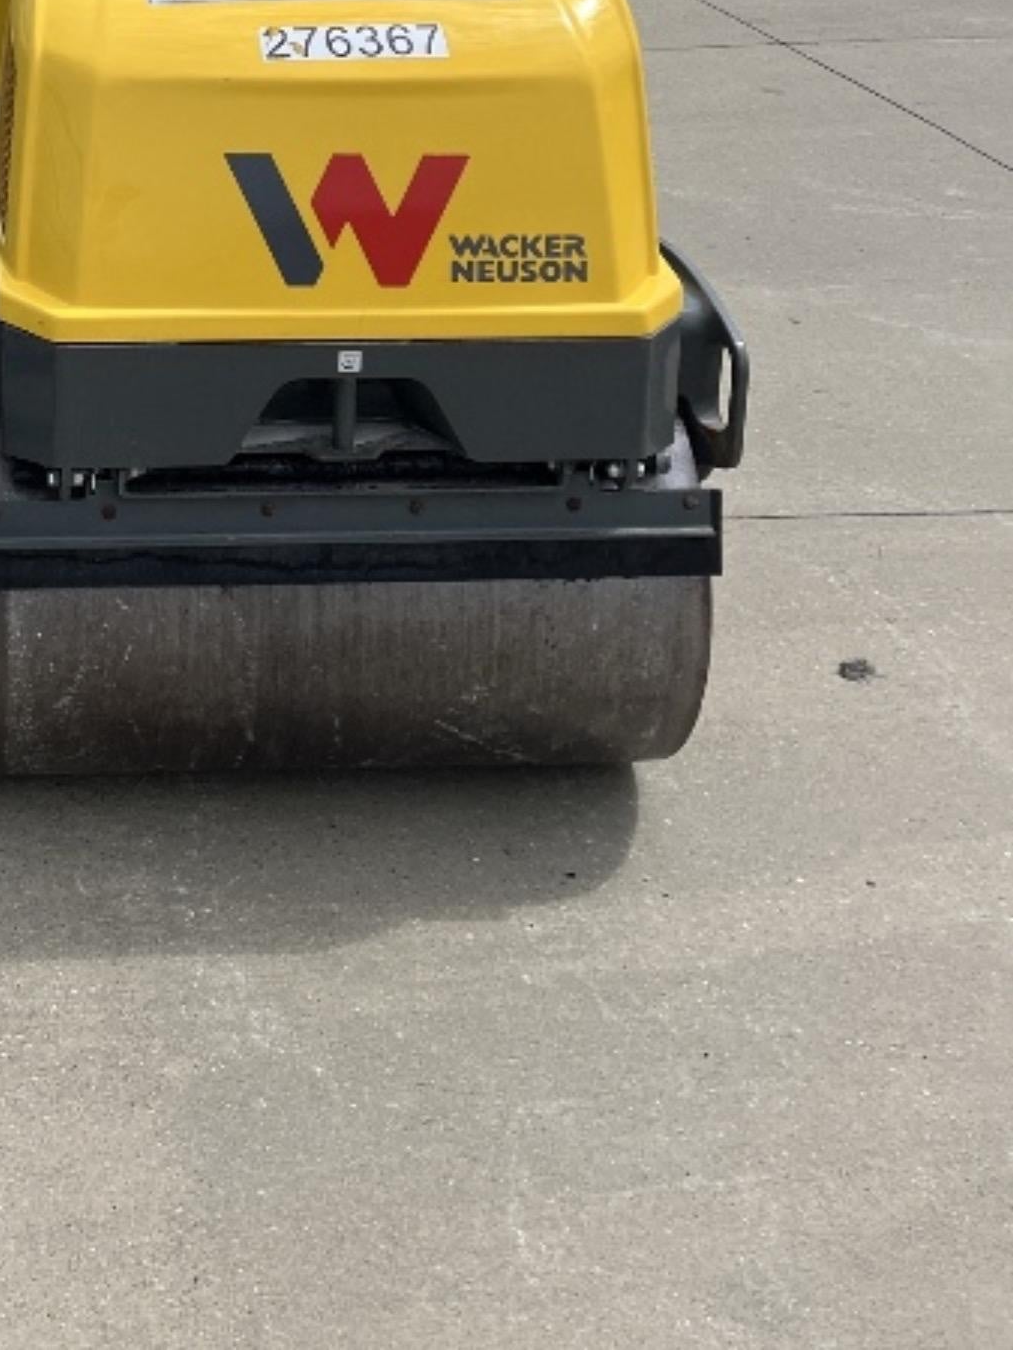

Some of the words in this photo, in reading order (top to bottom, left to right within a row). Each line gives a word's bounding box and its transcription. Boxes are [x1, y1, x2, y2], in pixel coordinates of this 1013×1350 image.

[263, 23, 439, 59] 276367
[448, 233, 587, 258] WACKER
[451, 259, 588, 283] NEUSON
